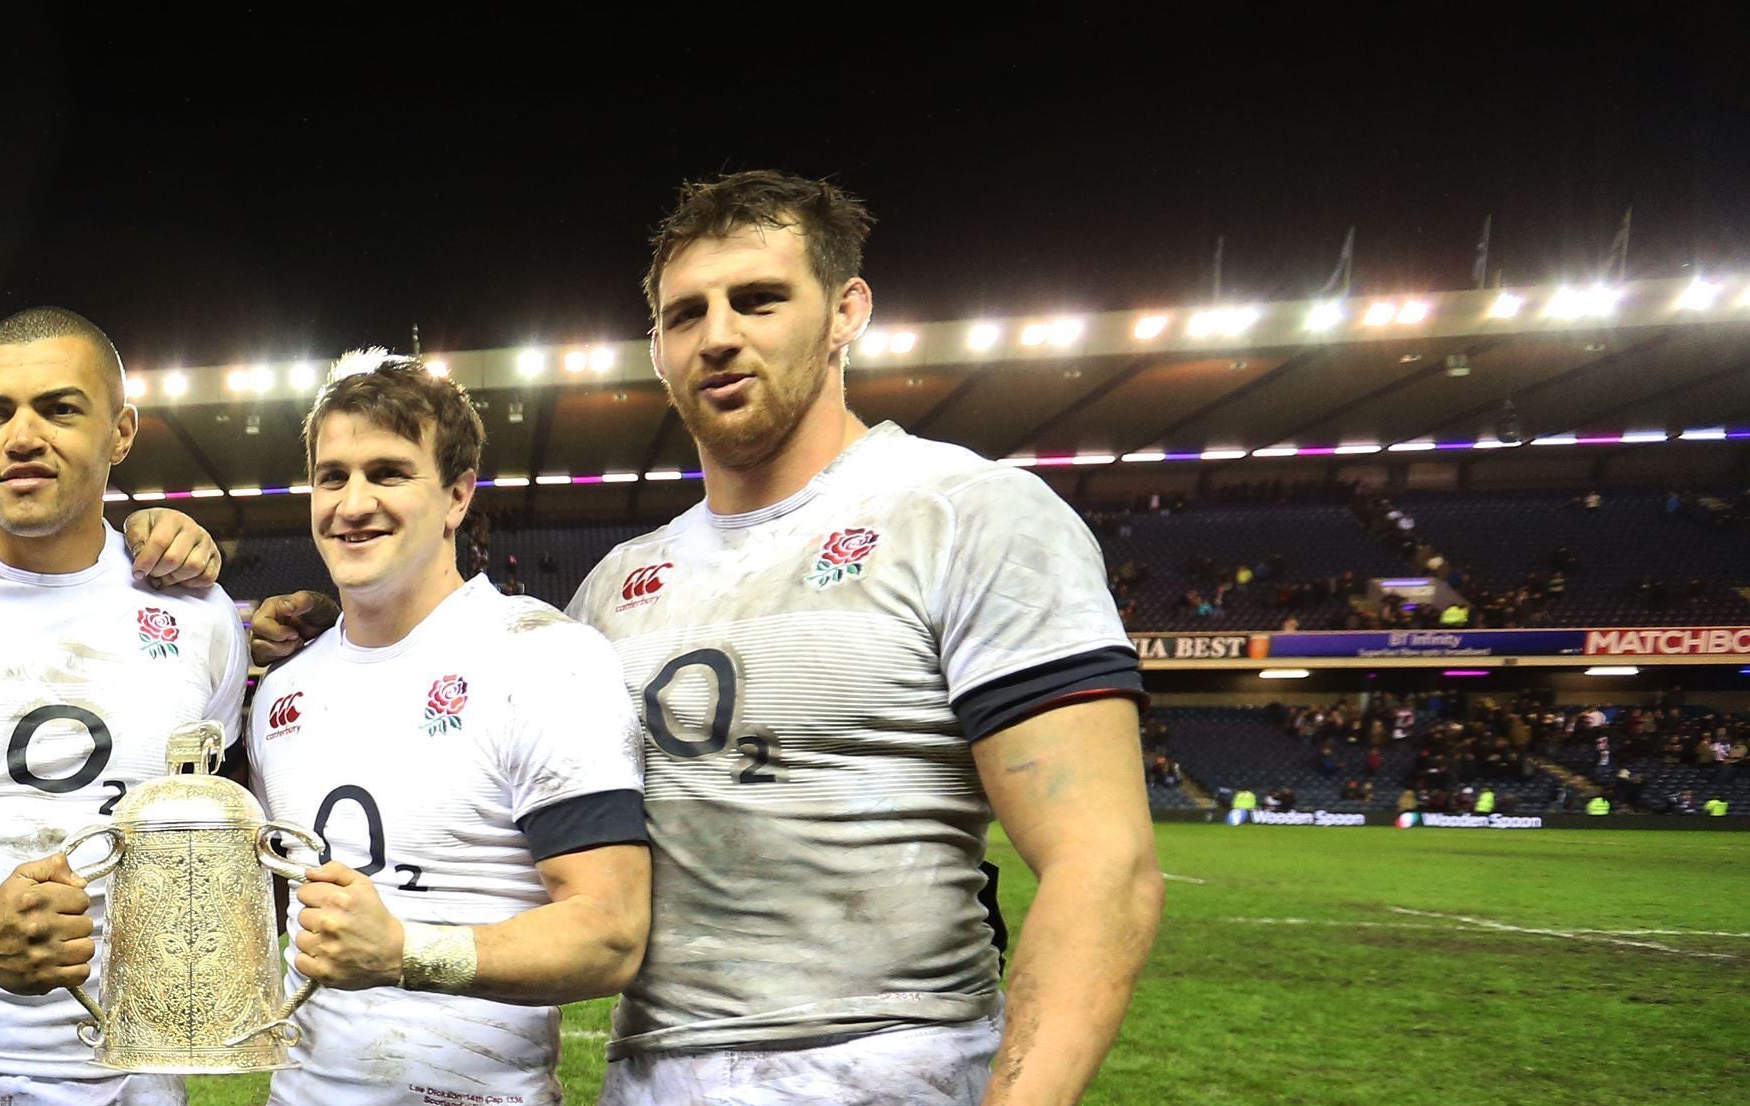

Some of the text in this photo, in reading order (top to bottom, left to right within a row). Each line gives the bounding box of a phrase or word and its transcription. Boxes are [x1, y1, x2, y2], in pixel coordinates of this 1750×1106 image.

[1175, 637, 1246, 658] BEST
[644, 648, 776, 784] O2
[7, 704, 127, 816] O2
[1252, 810, 1365, 826] Wooden Spoon
[1422, 812, 1542, 829] Wooden Spoon
[486, 1096, 504, 1105] Cap
